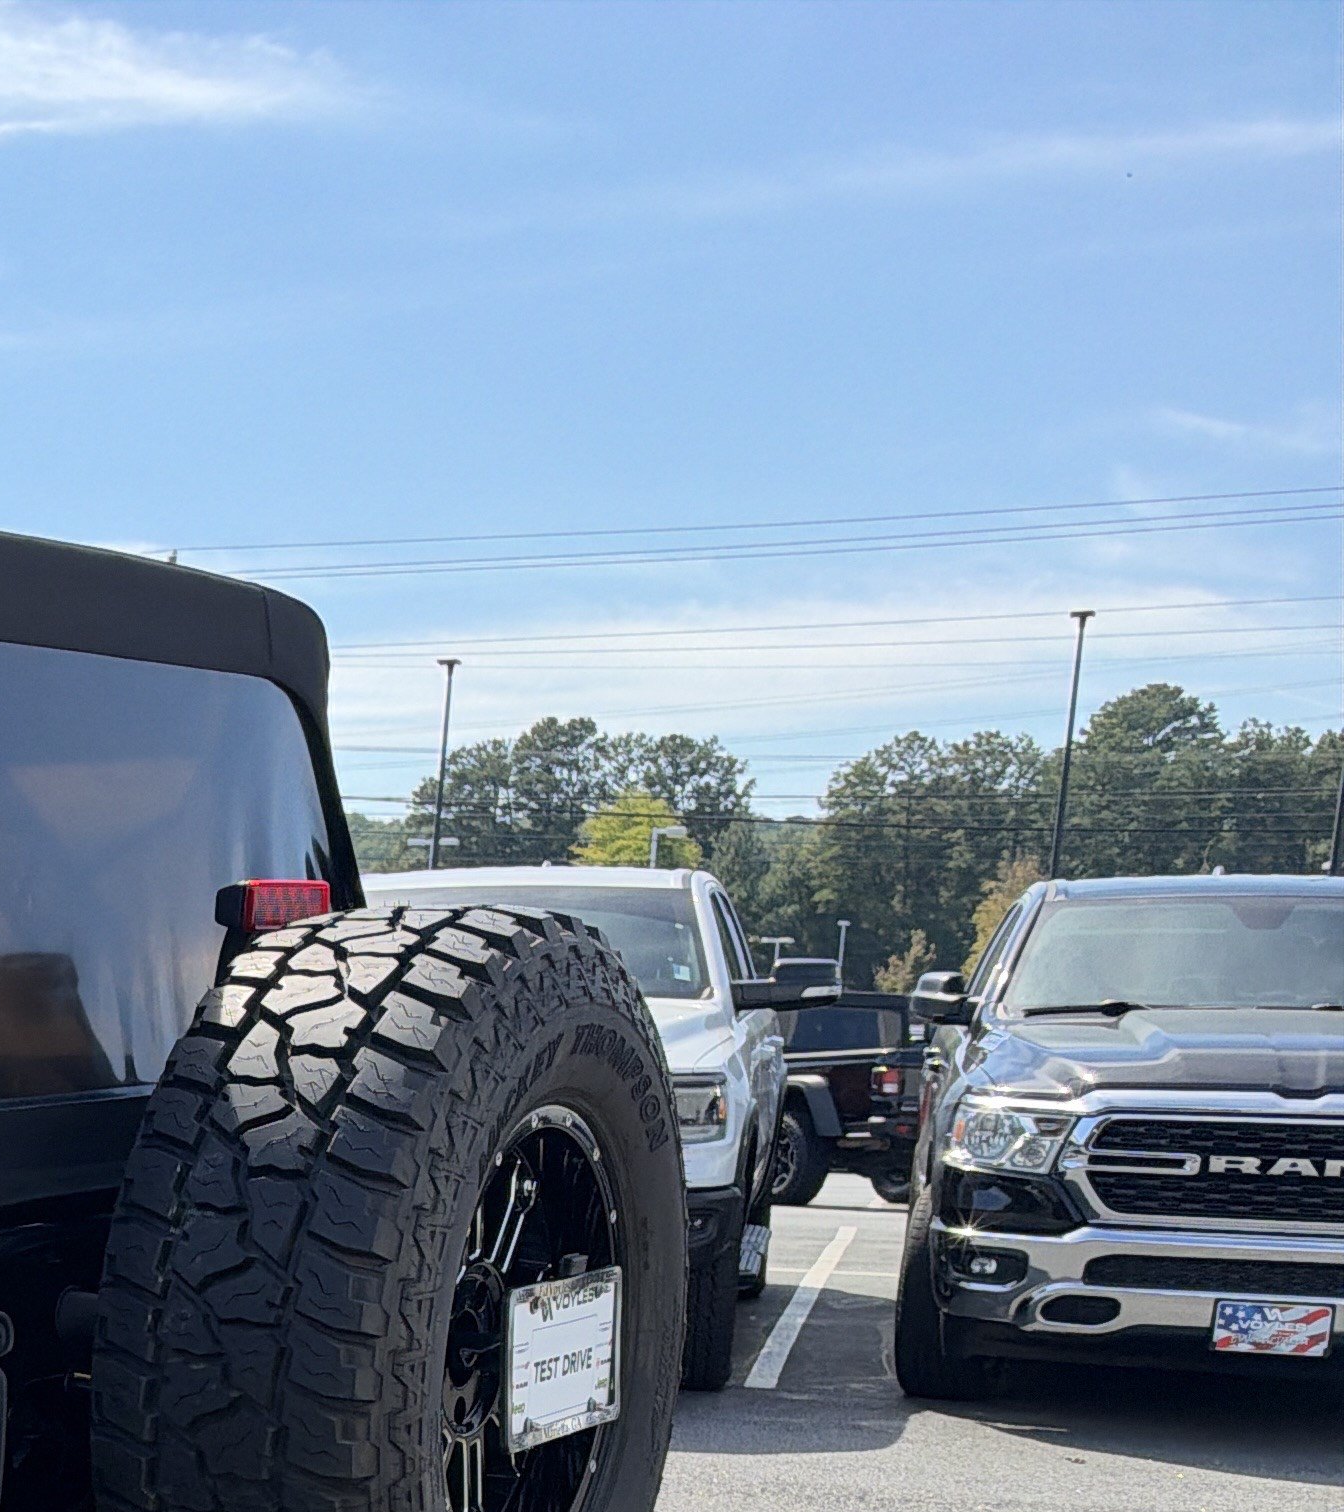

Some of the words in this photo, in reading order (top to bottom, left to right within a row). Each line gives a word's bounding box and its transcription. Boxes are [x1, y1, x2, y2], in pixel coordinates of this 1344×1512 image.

[570, 1024, 669, 1153] THOMPSON
[533, 1355, 561, 1384] TEST
[561, 1346, 593, 1377] DRIVE
